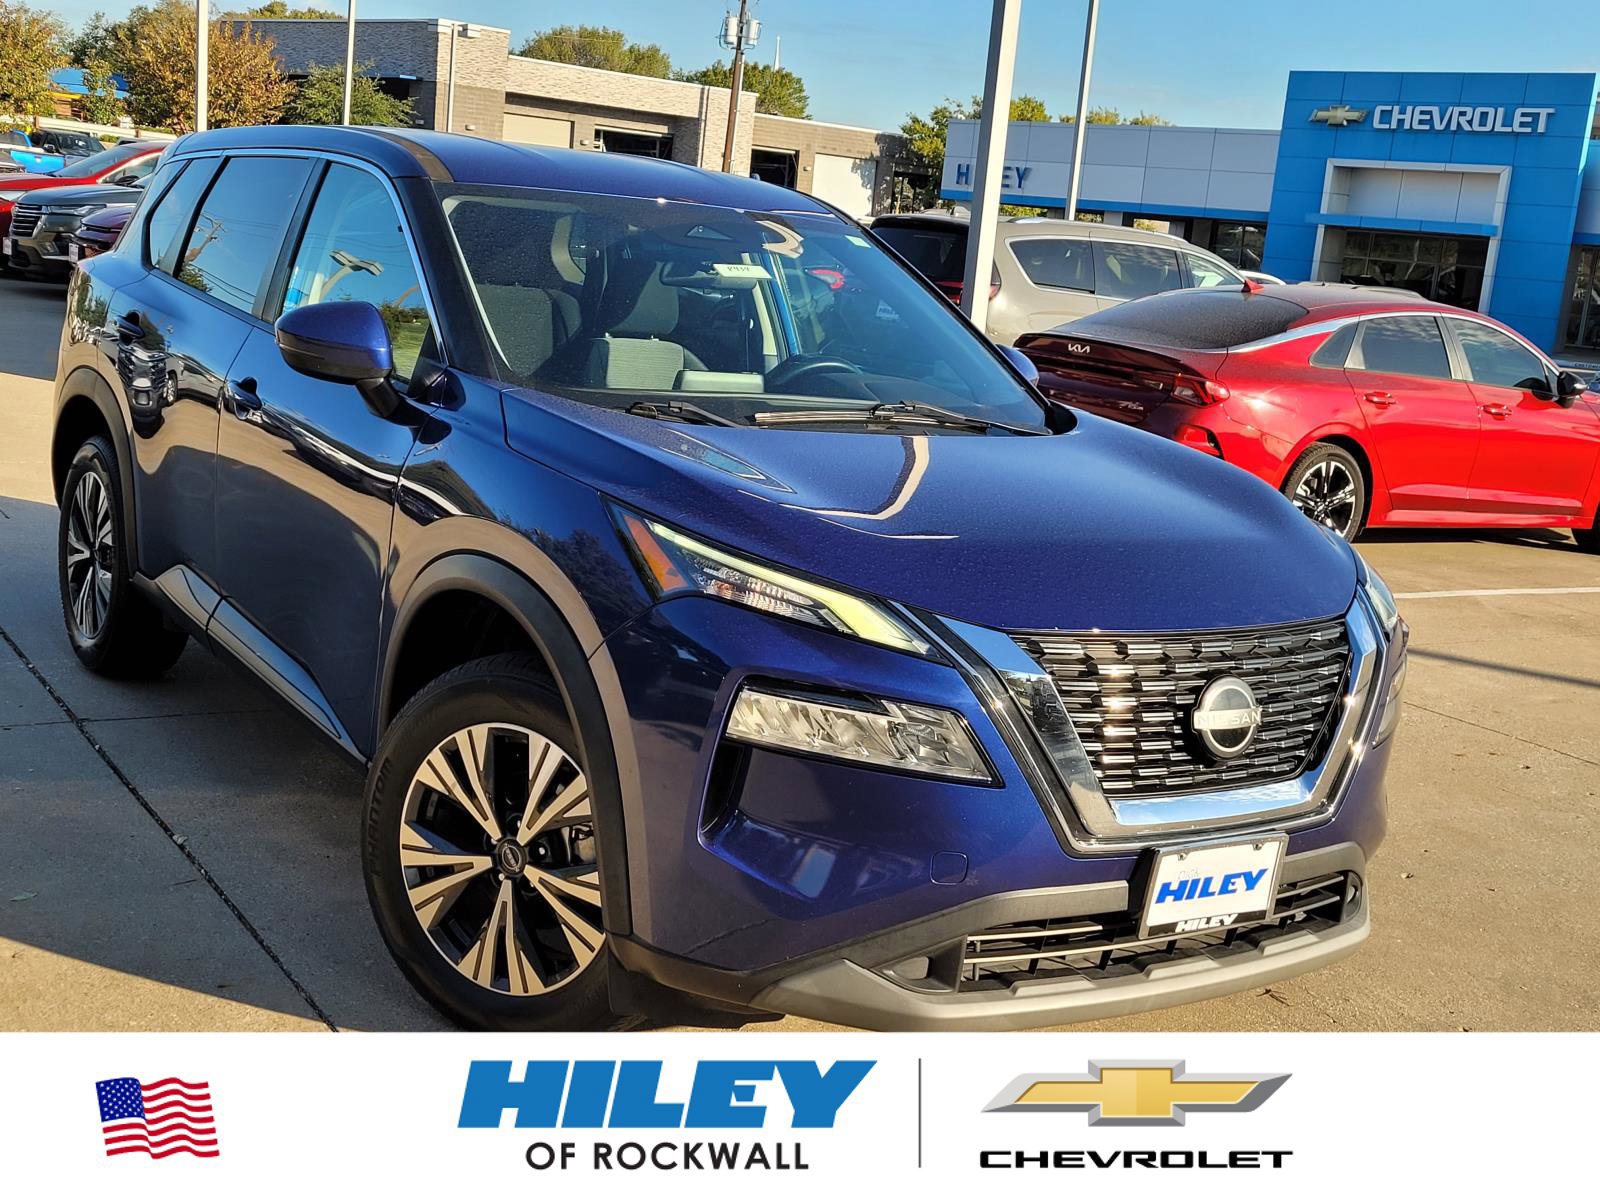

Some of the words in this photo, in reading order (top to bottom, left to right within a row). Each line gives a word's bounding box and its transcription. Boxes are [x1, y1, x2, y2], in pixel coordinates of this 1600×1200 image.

[1372, 105, 1556, 133] CHEVROLET
[955, 163, 1031, 189] HEY
[1068, 343, 1091, 354] KIA
[1154, 868, 1269, 904] HILEY
[1175, 913, 1238, 933] HILEY
